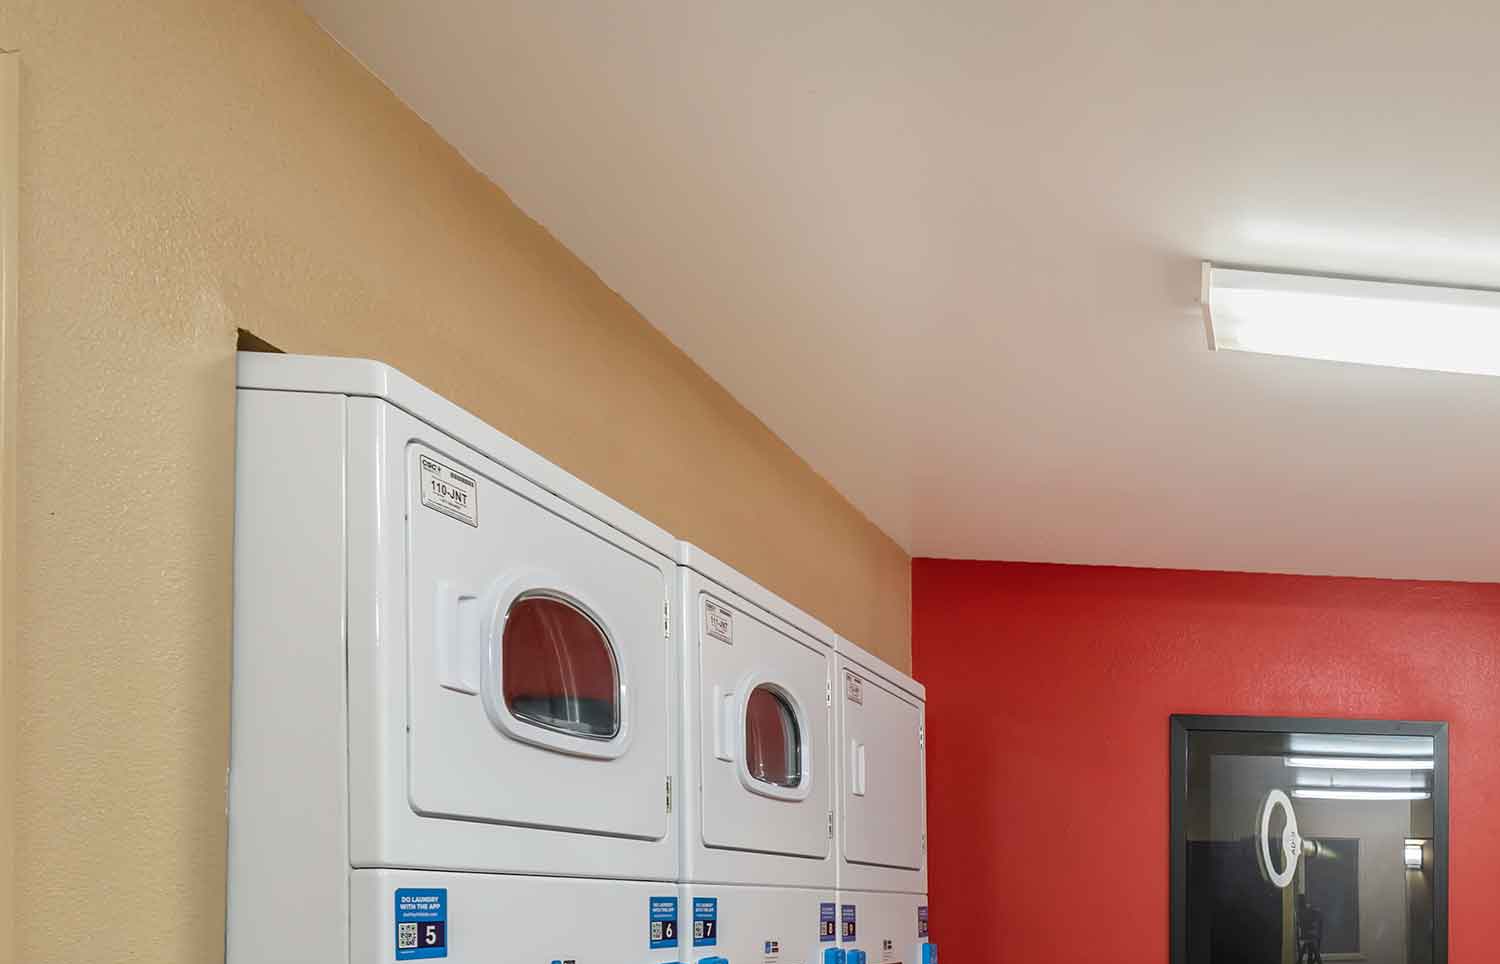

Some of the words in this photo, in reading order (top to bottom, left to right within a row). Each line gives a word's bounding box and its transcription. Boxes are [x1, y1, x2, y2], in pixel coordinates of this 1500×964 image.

[425, 925, 437, 945] 5
[665, 922, 673, 938] 6
[706, 922, 712, 937] 7
